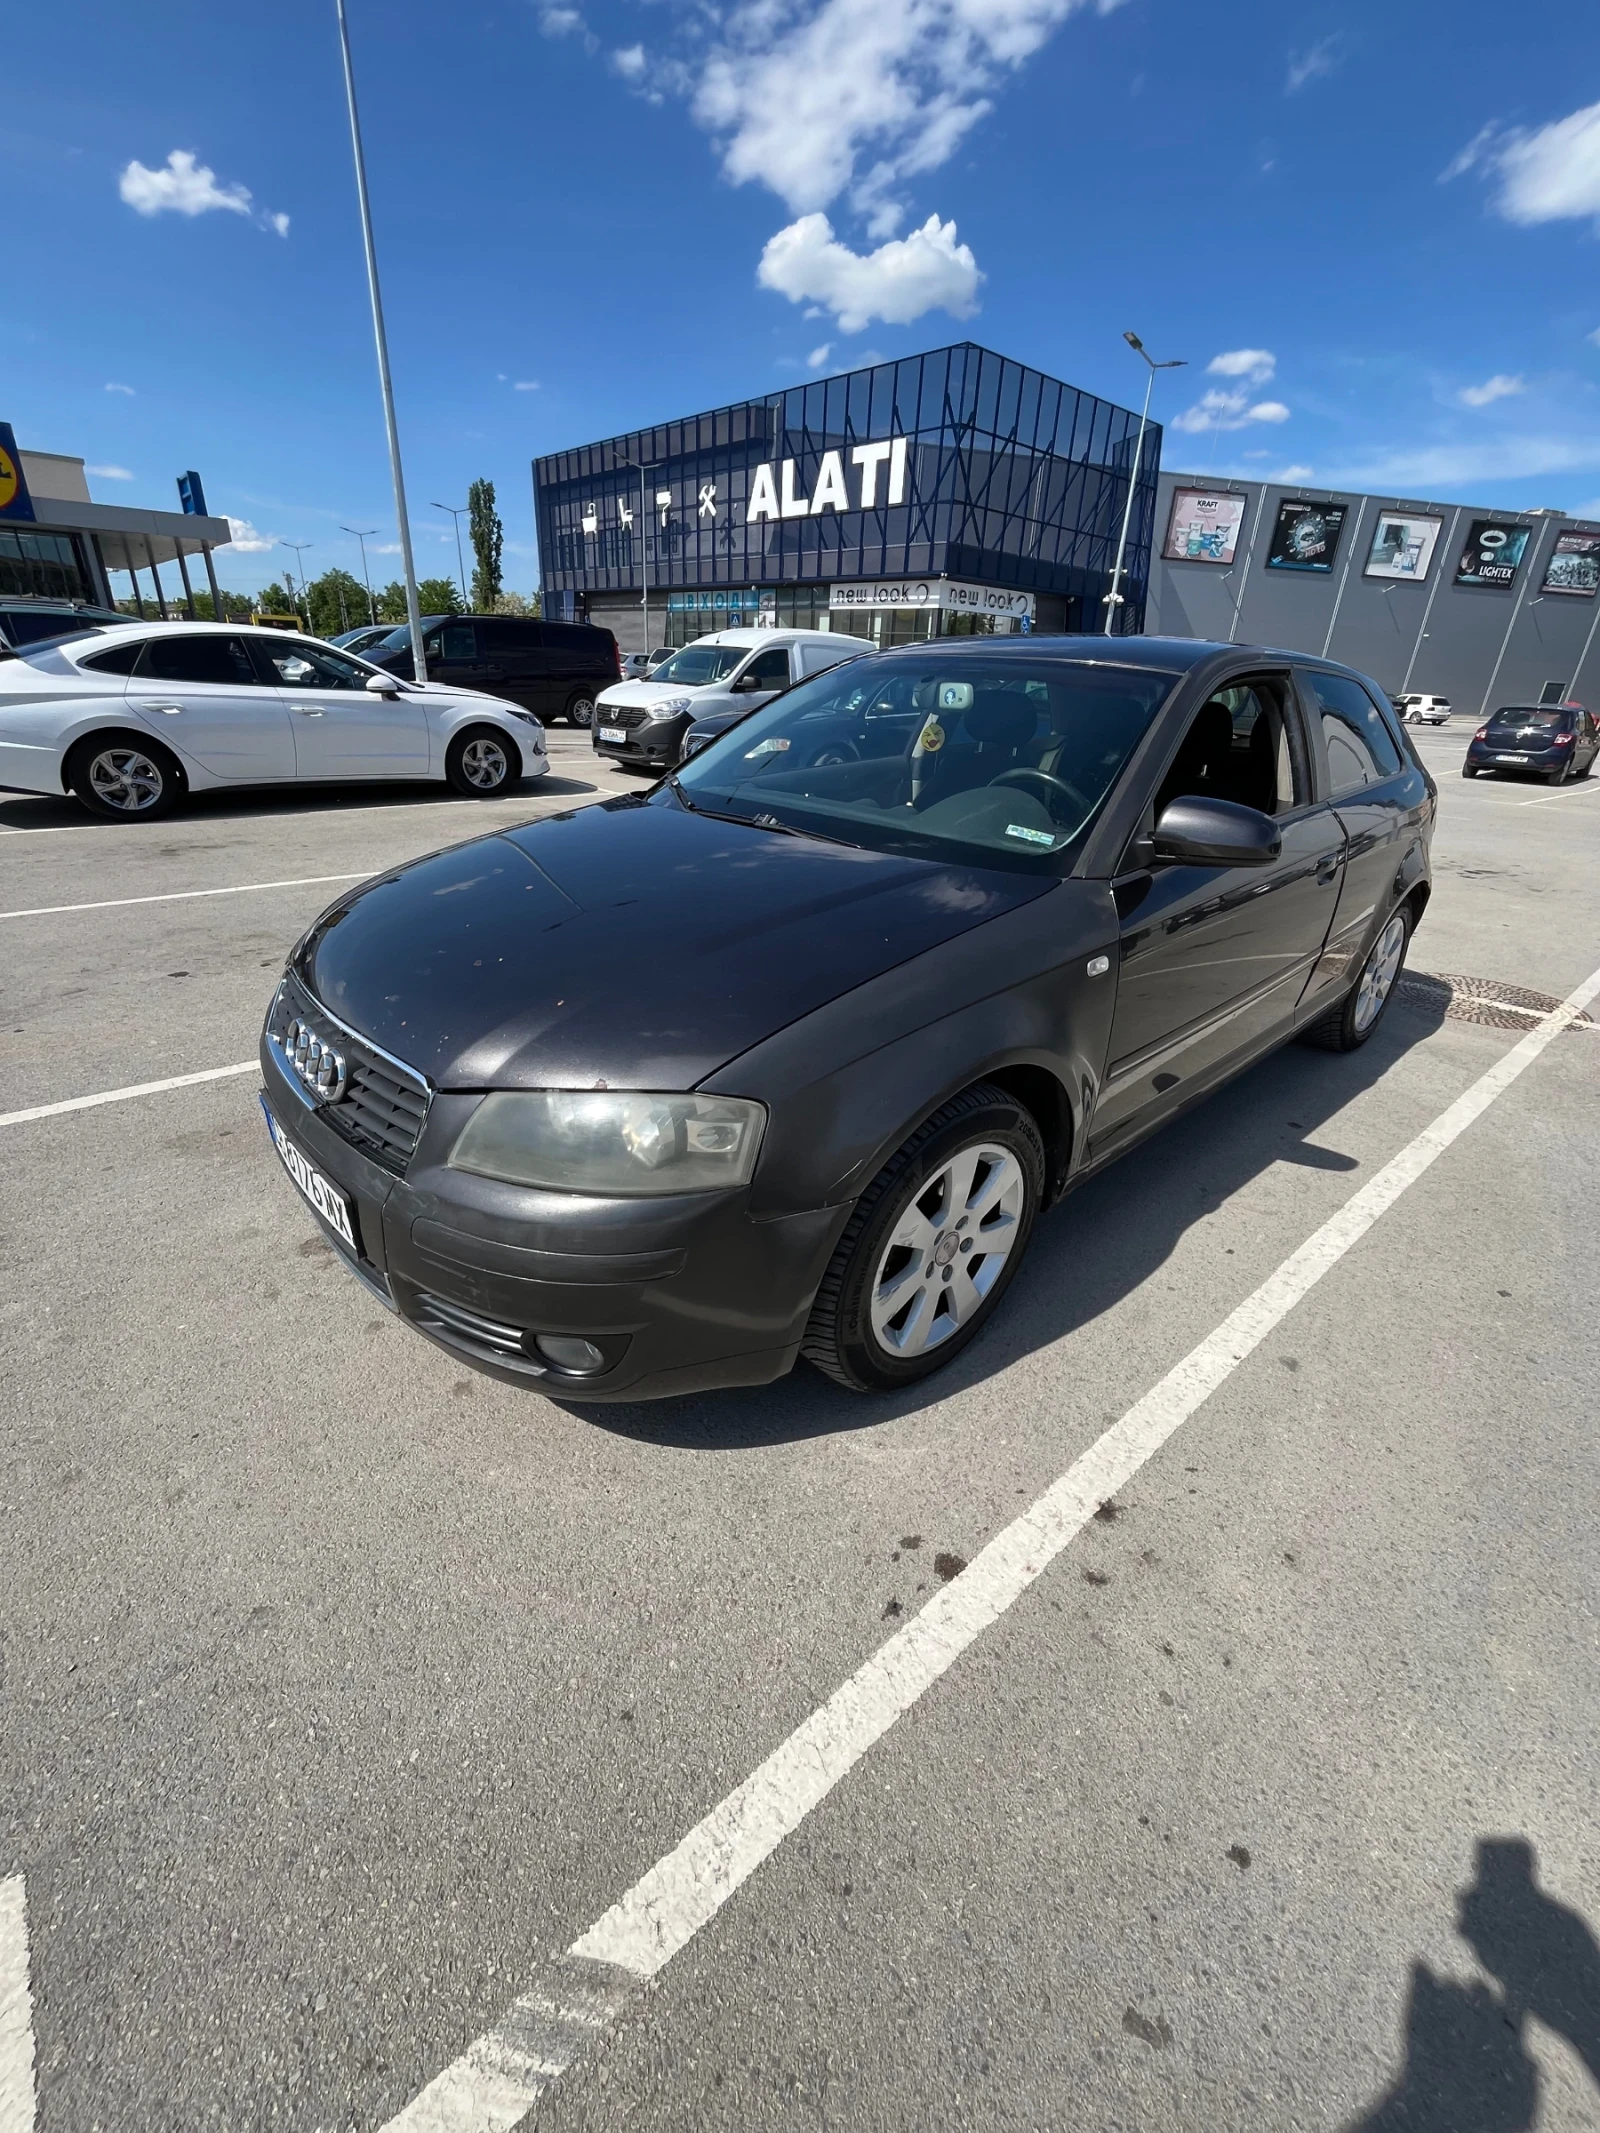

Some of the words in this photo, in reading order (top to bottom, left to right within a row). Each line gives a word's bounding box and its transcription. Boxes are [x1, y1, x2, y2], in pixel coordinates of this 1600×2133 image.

[746, 437, 907, 522] ALATI
[1197, 500, 1219, 508] KRAFT
[1479, 565, 1513, 579] LIGHTEX
[687, 592, 740, 610] ВХОД
[836, 587, 867, 604] new
[873, 583, 909, 603] look
[950, 586, 979, 607] new
[983, 588, 1015, 611] look
